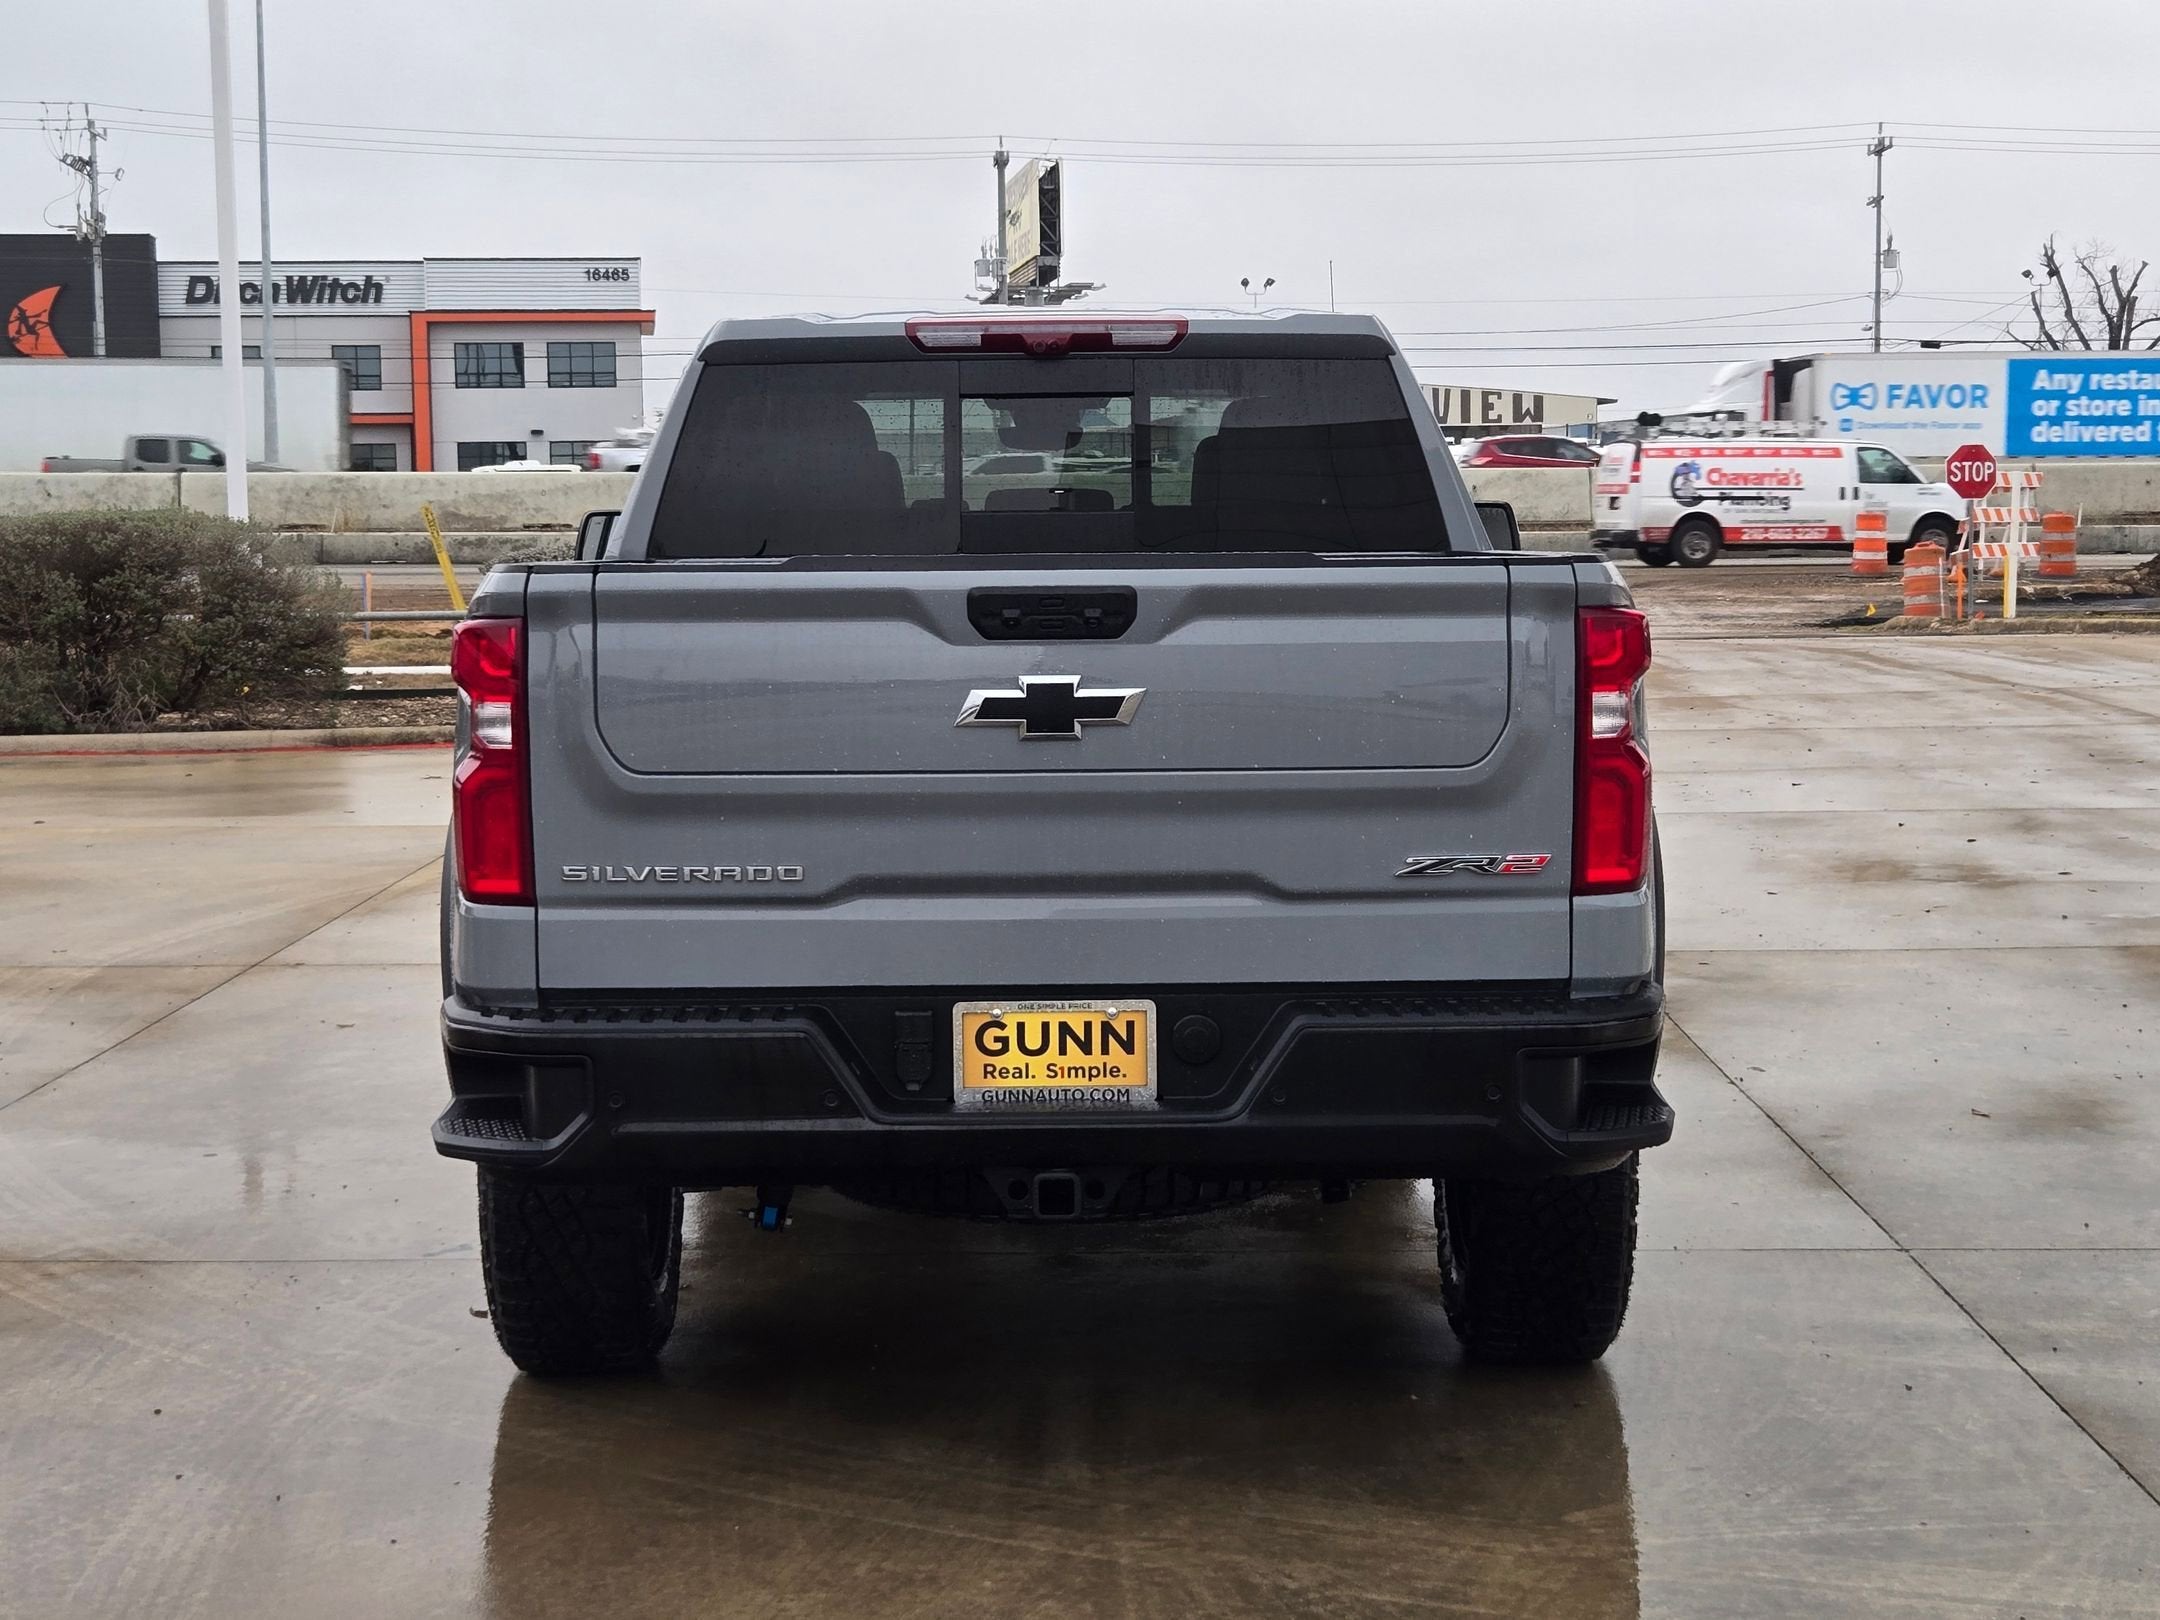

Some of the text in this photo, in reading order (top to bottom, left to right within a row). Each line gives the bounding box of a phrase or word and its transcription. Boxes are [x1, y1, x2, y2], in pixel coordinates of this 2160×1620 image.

[584, 267, 630, 281] 16465
[185, 275, 384, 304] Dch Witch
[2031, 369, 2084, 394] Any
[1420, 386, 1544, 425] VIEW
[1886, 383, 1989, 409] FAVOR
[2031, 400, 2060, 416] or
[2065, 396, 2132, 416] store
[2030, 421, 2152, 442] delivered
[1949, 461, 1994, 482] STOP
[561, 865, 804, 882] SILVERADO
[1395, 853, 1552, 877] ZR2
[1017, 1002, 1093, 1010] ONE SIMPLE PRICE
[974, 1020, 1136, 1057] GUNN
[983, 1062, 1036, 1080] Real.
[981, 1088, 1131, 1103] GUNNAUTO.COM
